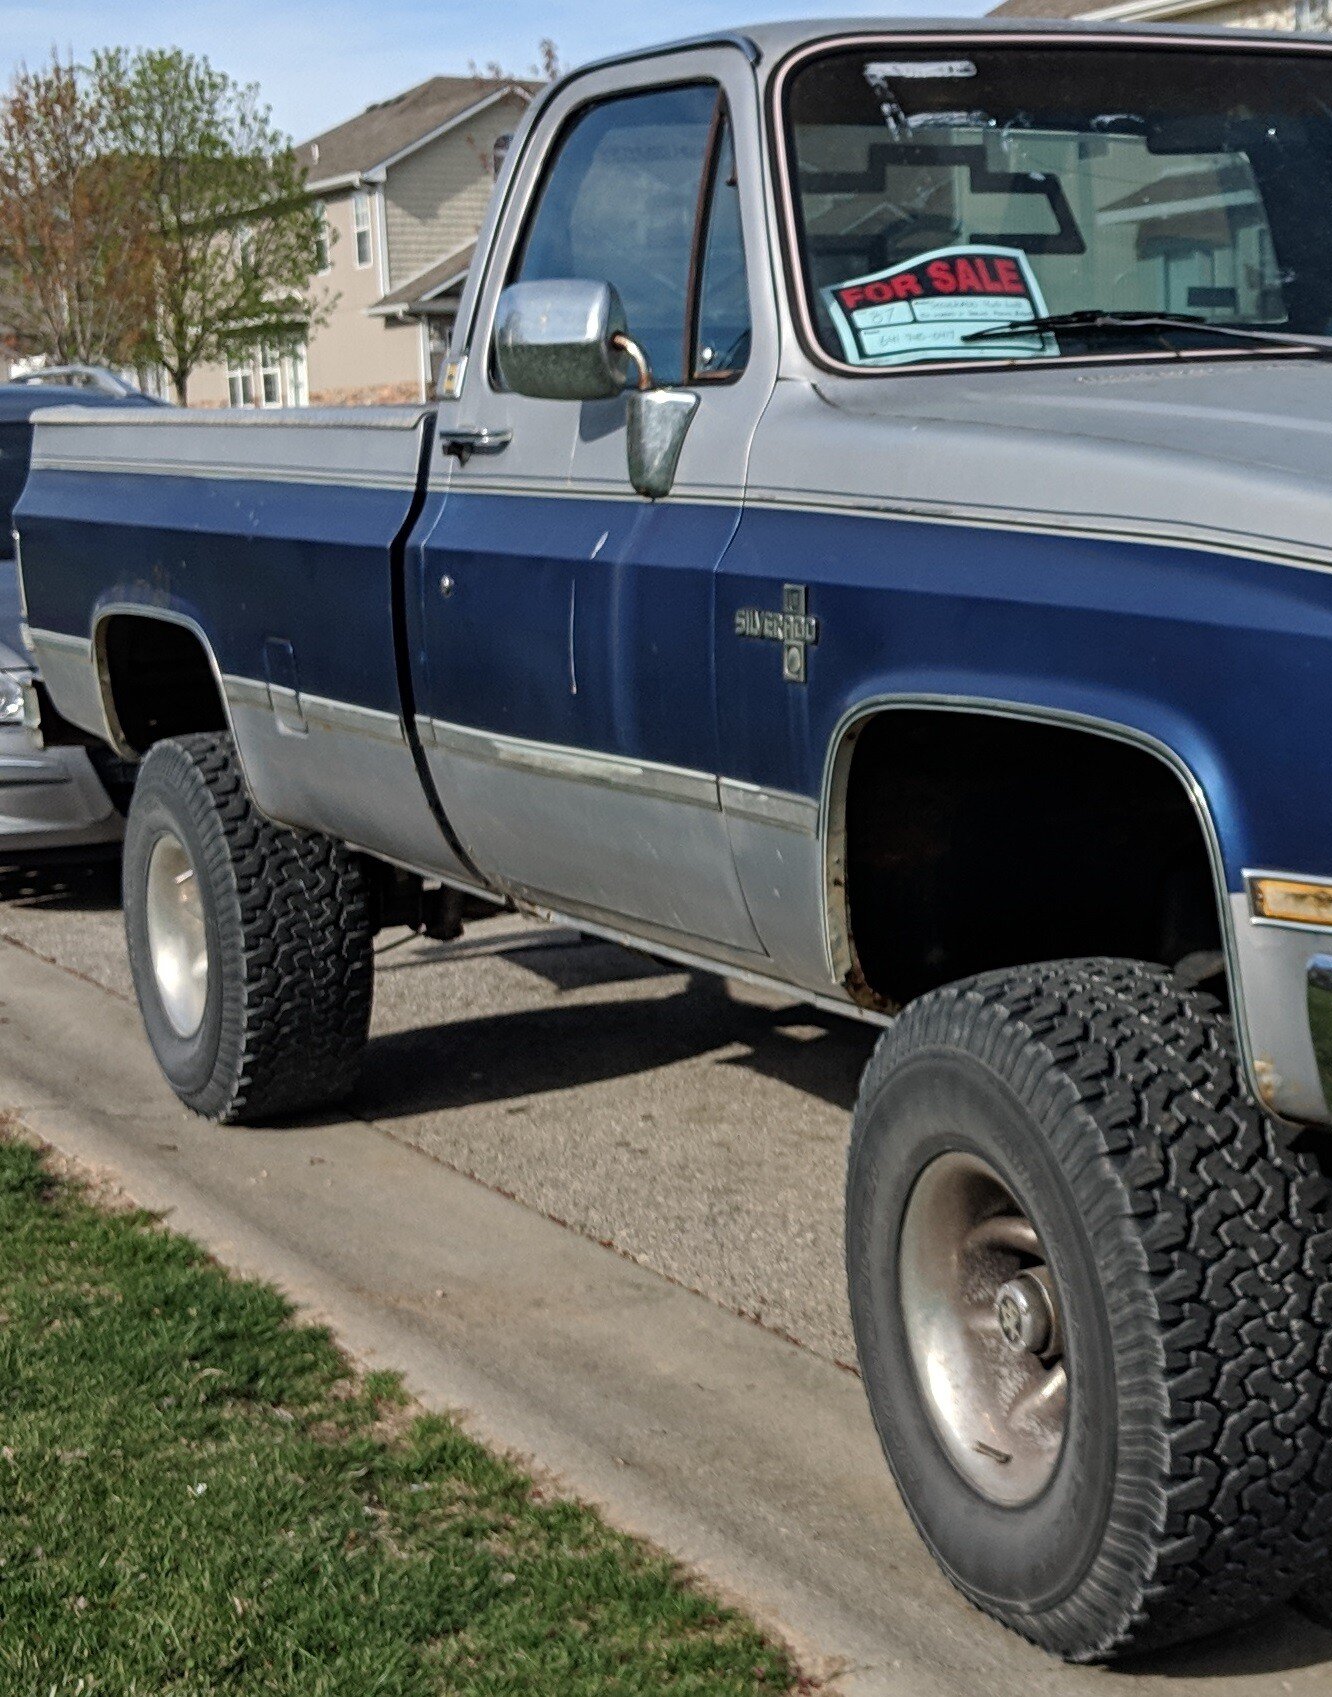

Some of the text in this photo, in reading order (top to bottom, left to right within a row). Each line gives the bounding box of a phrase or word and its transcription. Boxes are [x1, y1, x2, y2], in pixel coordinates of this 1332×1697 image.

[839, 256, 1026, 309] FOR SALE
[735, 608, 816, 643] SILVERADO
